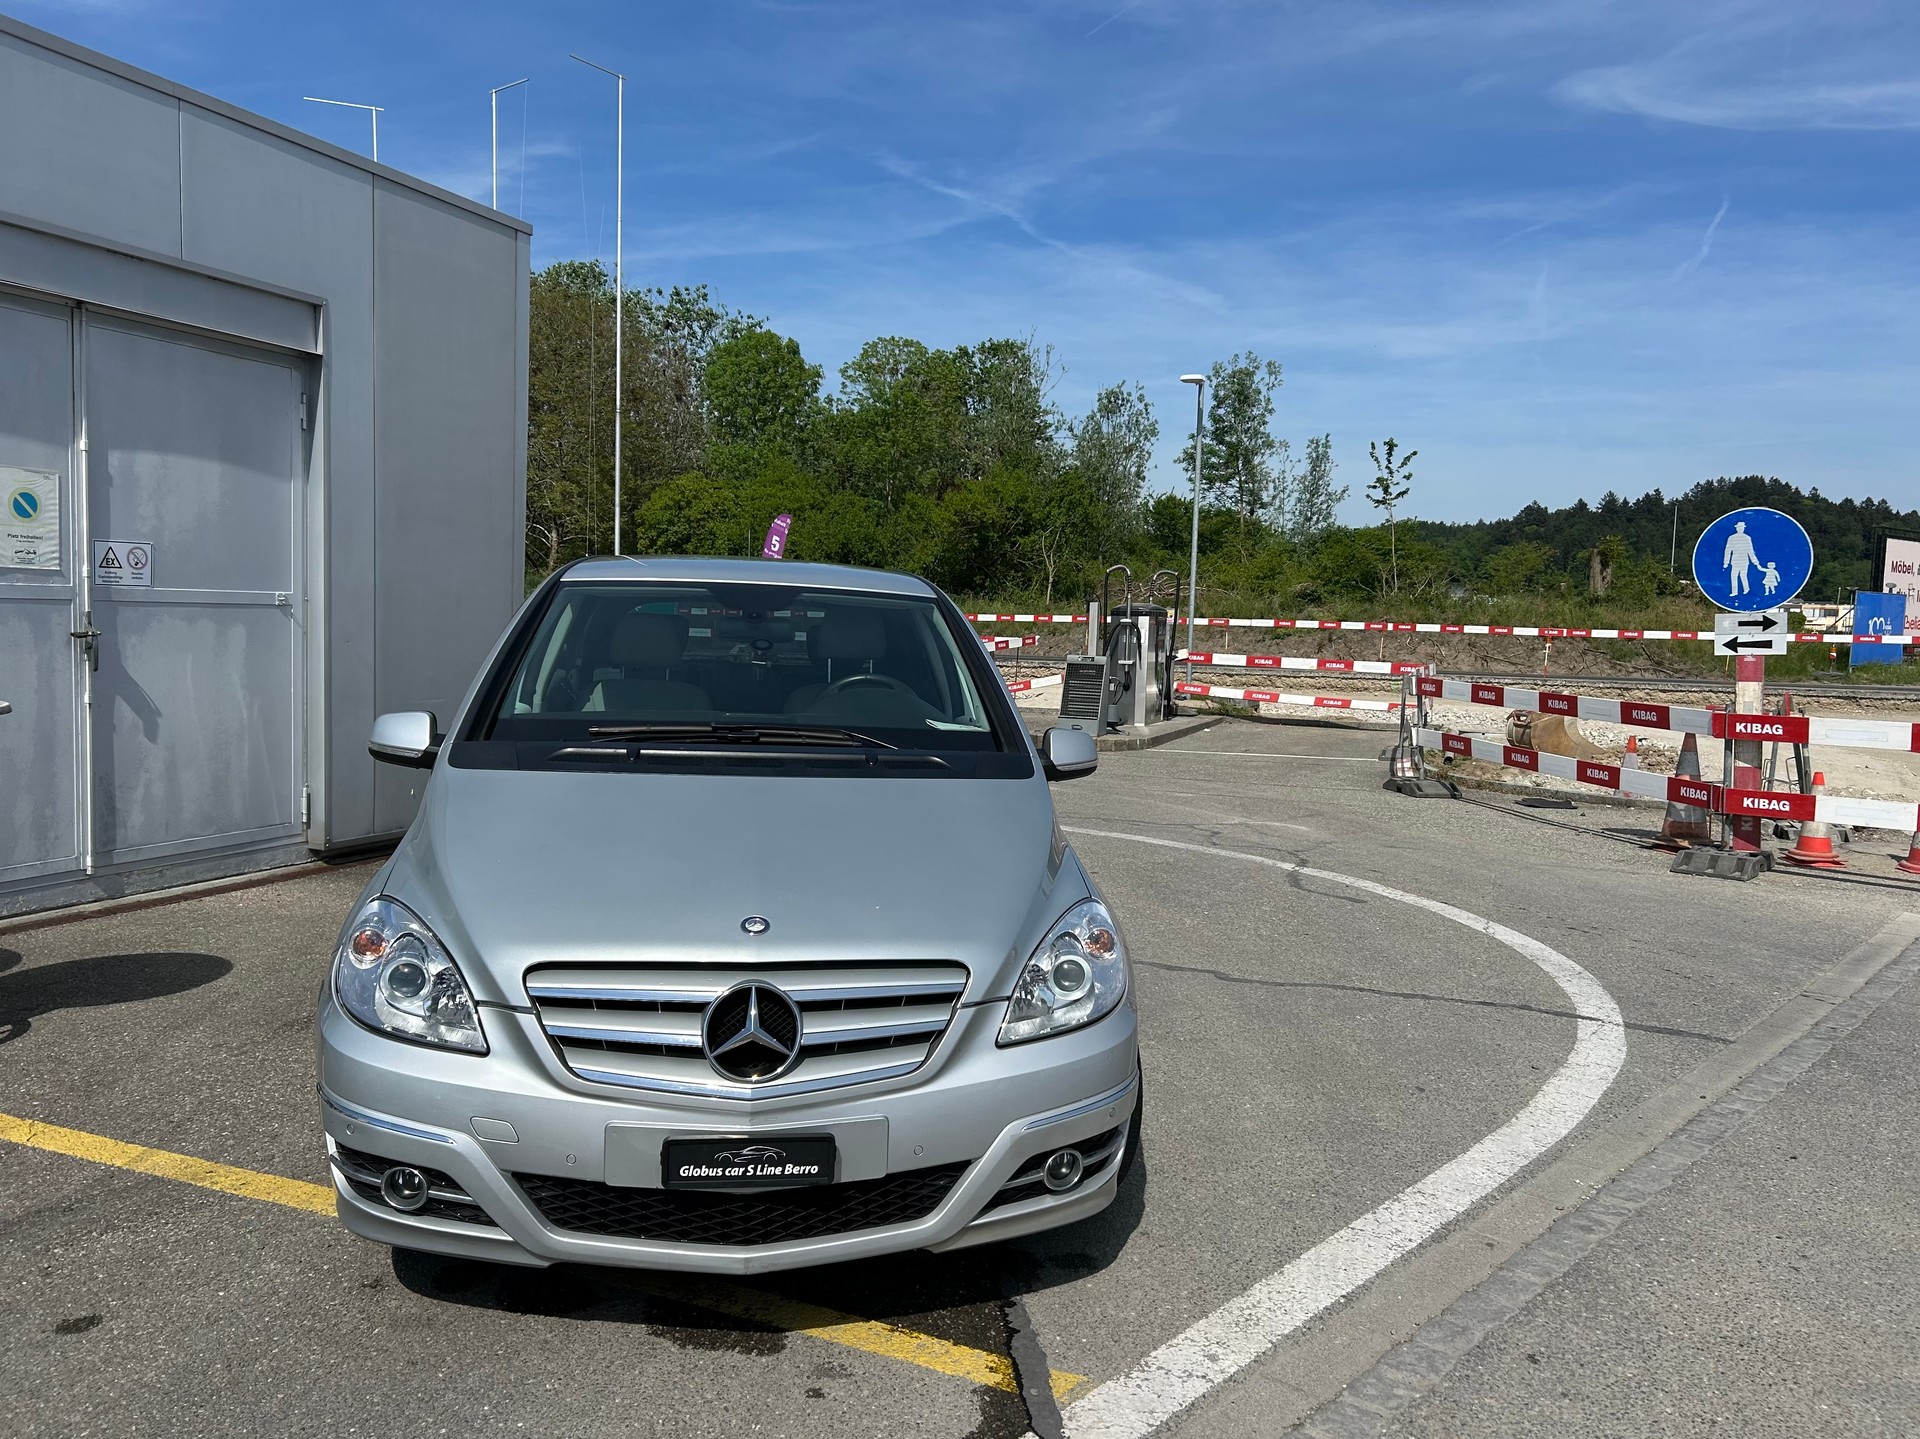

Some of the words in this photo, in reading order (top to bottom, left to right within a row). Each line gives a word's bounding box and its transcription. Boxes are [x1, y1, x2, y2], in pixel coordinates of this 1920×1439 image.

[771, 535, 780, 552] 5
[105, 557, 116, 566] EX
[1891, 561, 1916, 577] Möbel,
[1421, 683, 1436, 692] KIBAG
[1478, 690, 1496, 700] KIBAG
[1547, 699, 1568, 710] KIBAG
[1632, 709, 1657, 722] KIBAG
[1735, 722, 1783, 735] KIBAG
[1448, 739, 1465, 750] KIBAG
[1511, 752, 1530, 764] KIBAG
[1586, 767, 1609, 780] KIBAG
[1680, 786, 1708, 801] KIBAG
[1742, 797, 1790, 812] KIBAG
[679, 1165, 722, 1177] Globus
[725, 1166, 745, 1176] car
[746, 1164, 755, 1176] S
[756, 1163, 782, 1176] Line
[785, 1163, 819, 1175] Berro
